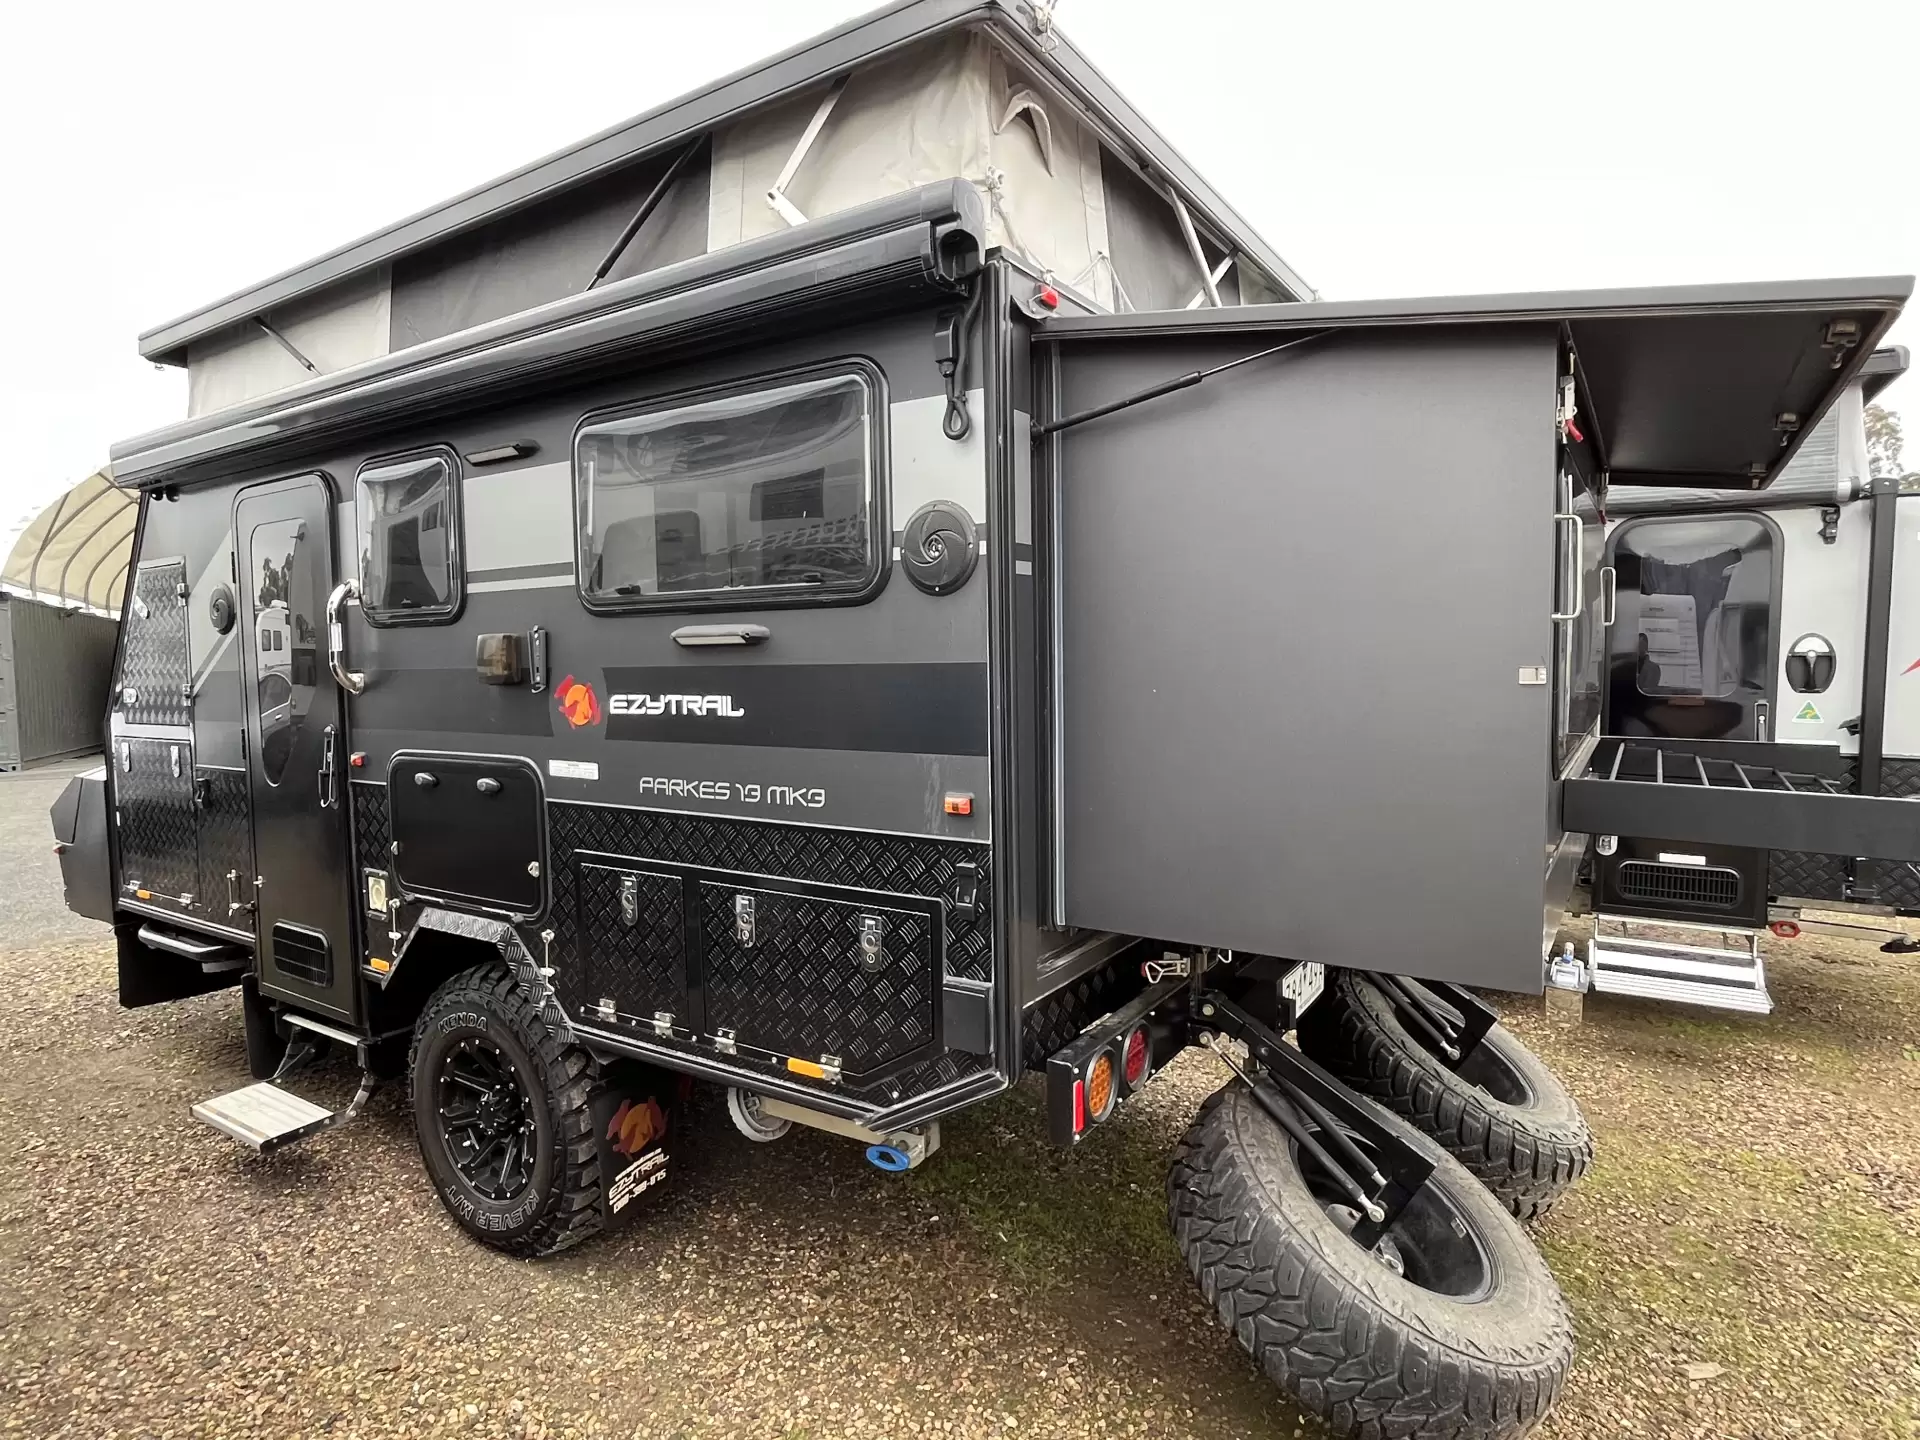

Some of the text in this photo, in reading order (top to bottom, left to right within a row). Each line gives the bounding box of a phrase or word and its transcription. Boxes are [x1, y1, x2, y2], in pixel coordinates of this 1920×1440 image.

[609, 694, 745, 717] EZYTRAIL
[639, 776, 731, 800] PARKES
[767, 785, 826, 809] MK3
[437, 1011, 487, 1038] KENDA
[475, 1188, 541, 1231] KLEVER
